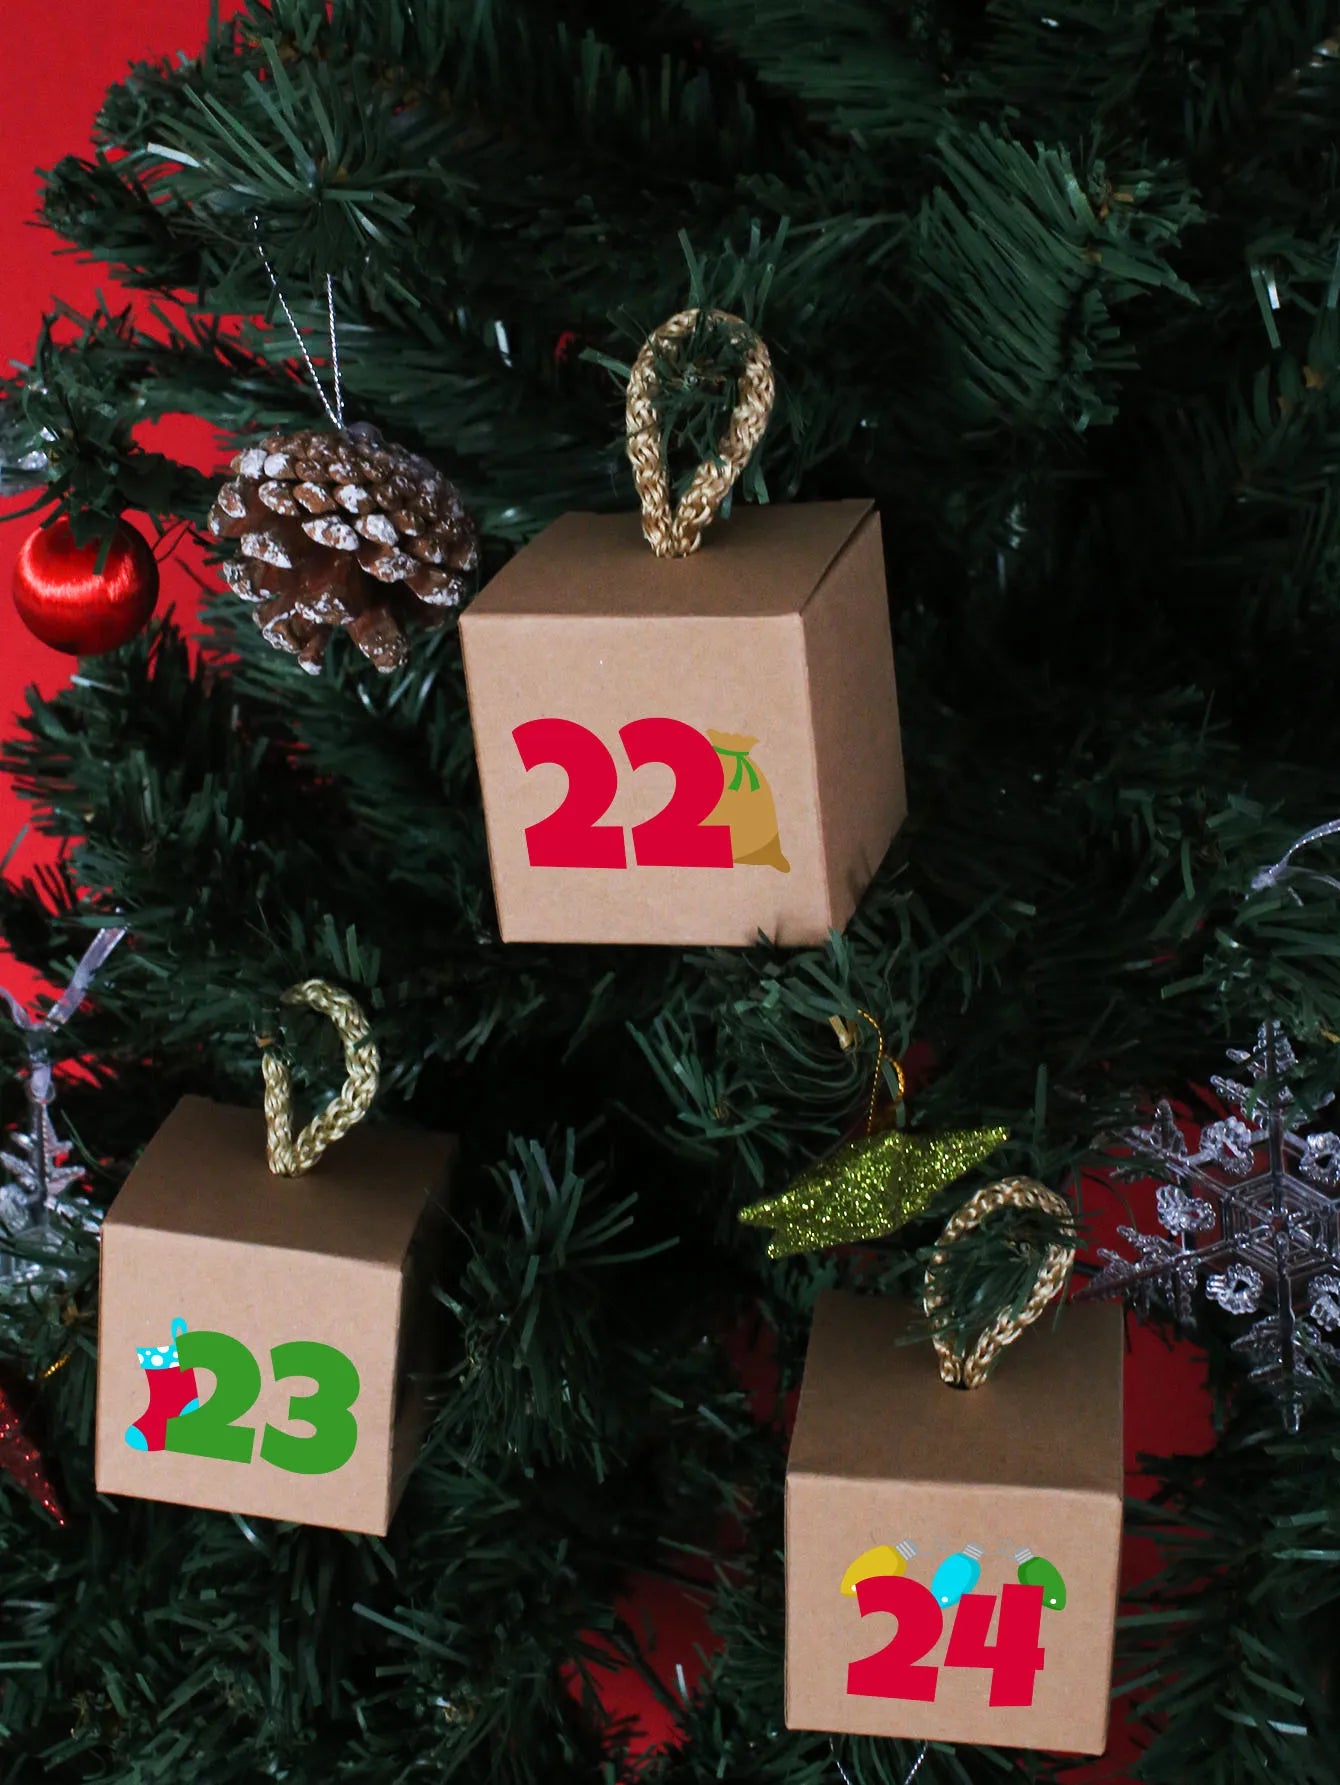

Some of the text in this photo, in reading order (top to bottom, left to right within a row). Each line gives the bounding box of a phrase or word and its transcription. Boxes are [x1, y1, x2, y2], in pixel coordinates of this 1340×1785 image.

[511, 717, 734, 869] 22
[166, 1331, 360, 1475] 23
[846, 1575, 1046, 1707] 24
